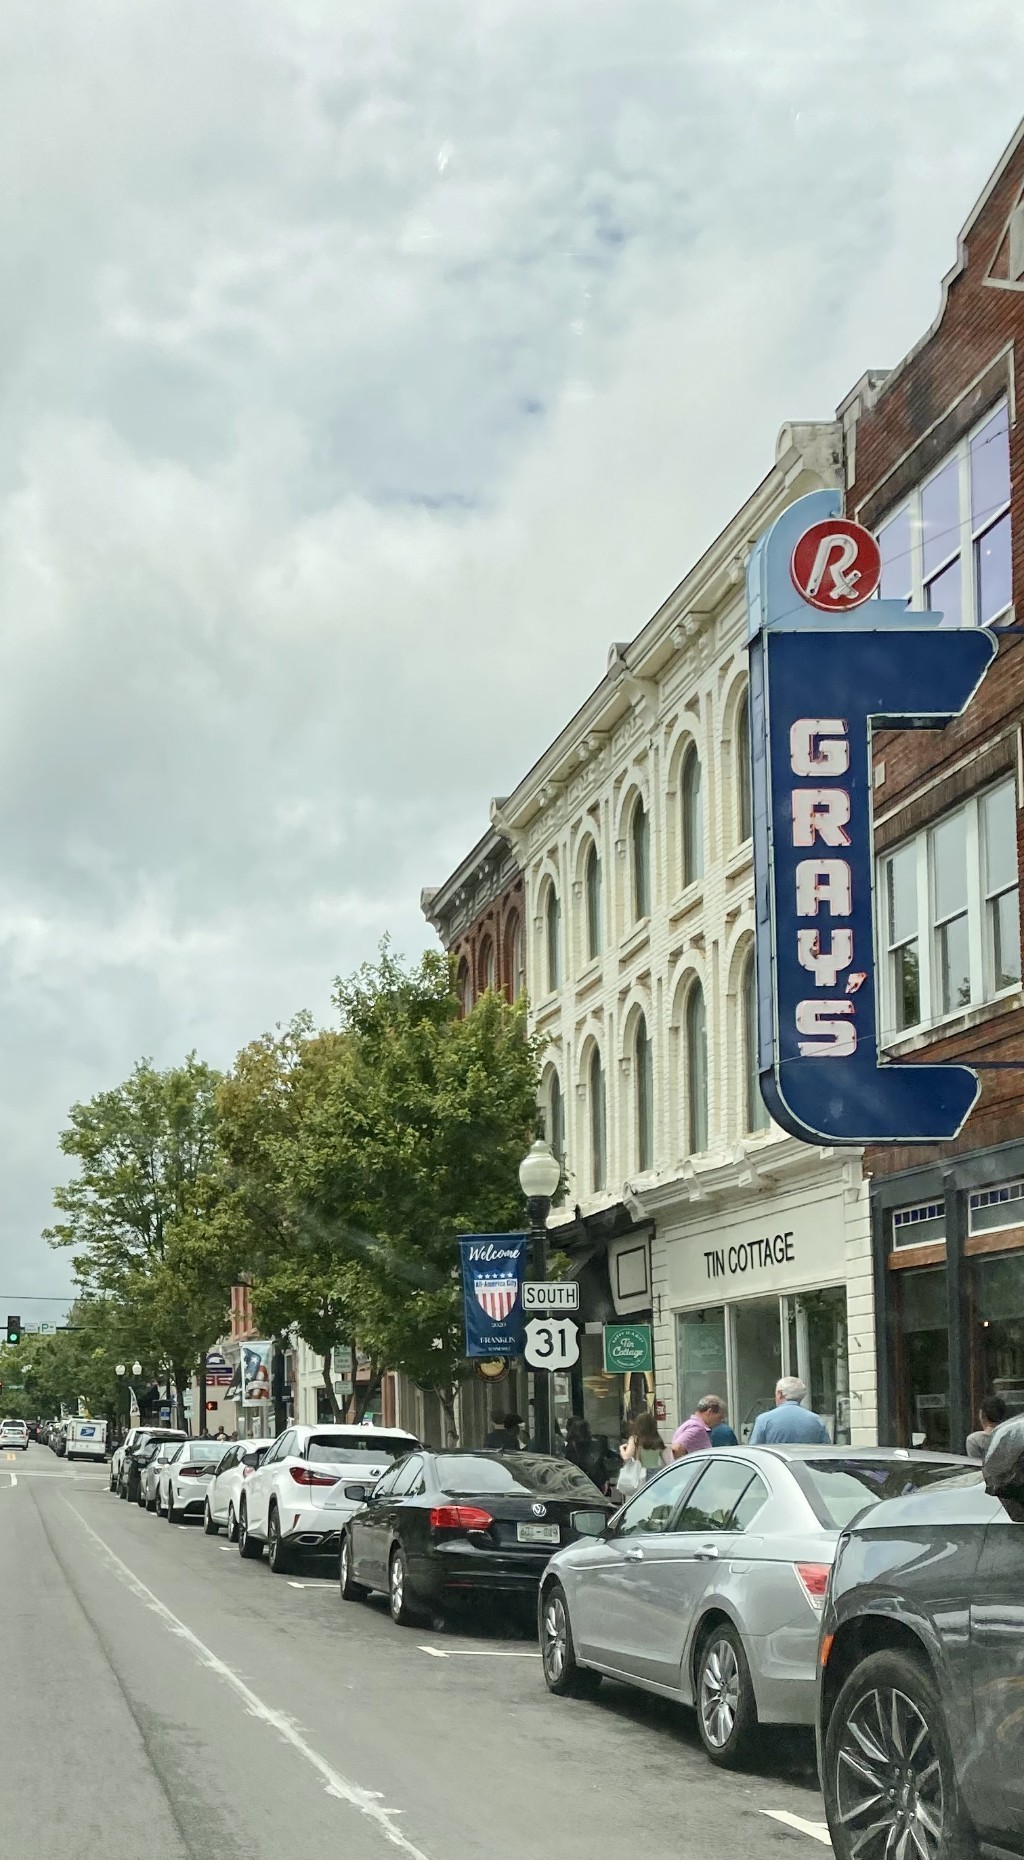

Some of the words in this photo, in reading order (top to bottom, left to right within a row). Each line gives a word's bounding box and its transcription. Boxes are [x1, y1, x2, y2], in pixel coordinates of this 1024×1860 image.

[790, 718, 868, 1058] GRAY'S
[469, 1244, 520, 1261] Welcome
[704, 1249, 725, 1278] TIN
[728, 1231, 795, 1274] COTTAGE
[526, 1287, 575, 1304] SOUTH
[479, 1336, 516, 1344] FRANKLIN
[535, 1328, 567, 1357] 31
[620, 1338, 635, 1348] Tin
[612, 1346, 644, 1359] Cottage
